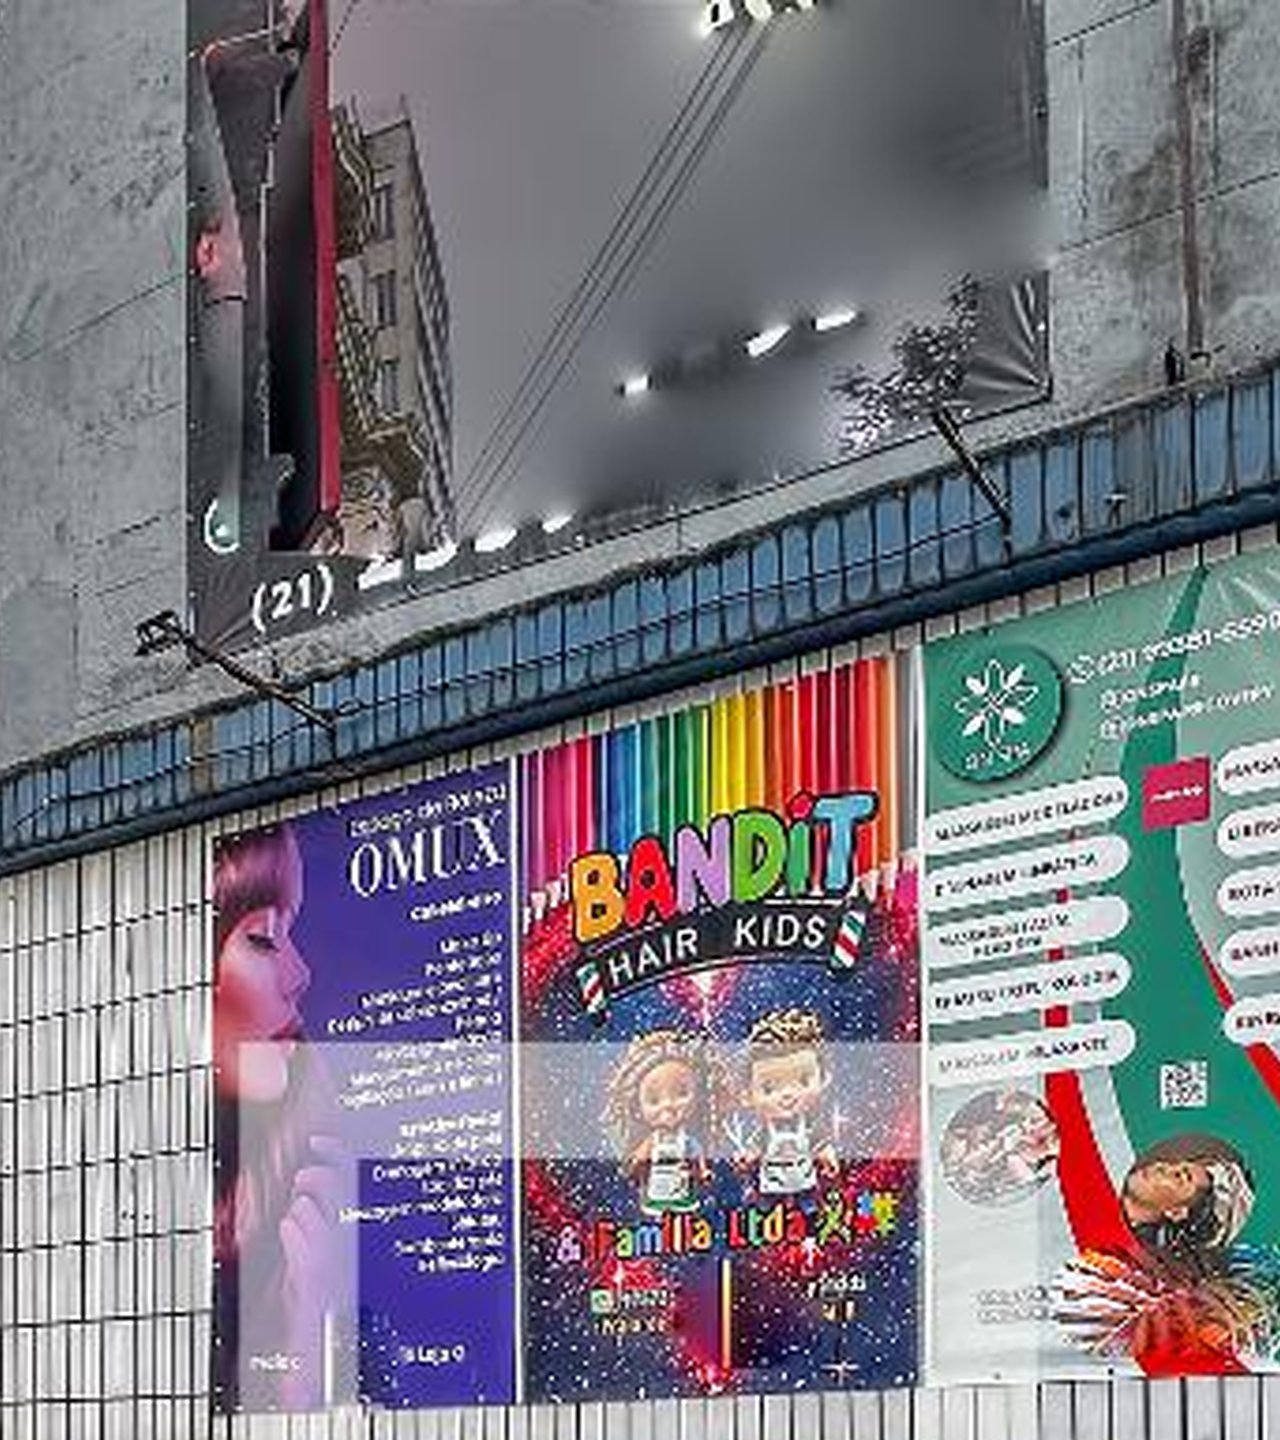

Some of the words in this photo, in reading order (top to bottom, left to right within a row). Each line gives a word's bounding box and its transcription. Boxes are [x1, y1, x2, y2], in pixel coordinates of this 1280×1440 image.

[252, 563, 334, 633] (21)
[350, 809, 507, 898] OMUX
[606, 928, 700, 987] HAIR
[733, 912, 828, 949] KIDS
[728, 1202, 808, 1248] Ltda
